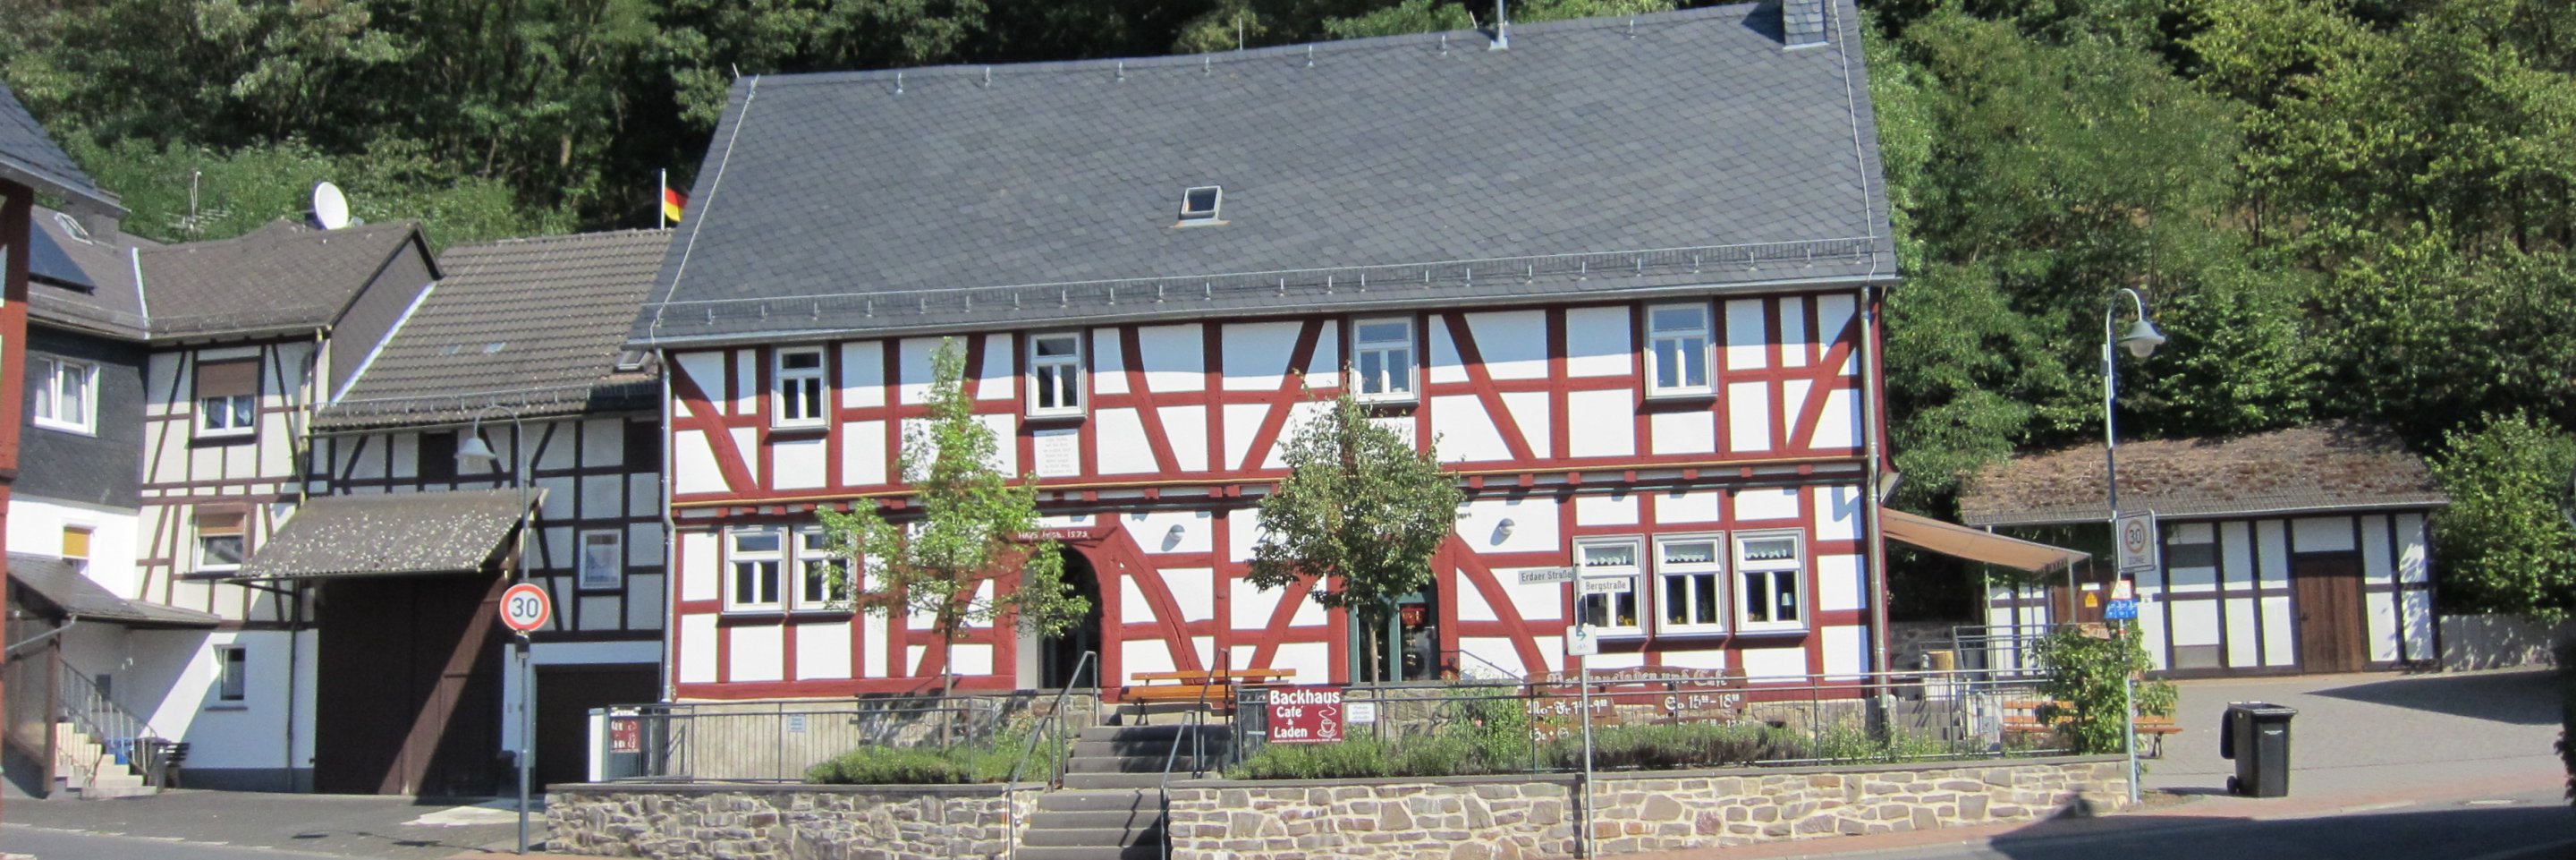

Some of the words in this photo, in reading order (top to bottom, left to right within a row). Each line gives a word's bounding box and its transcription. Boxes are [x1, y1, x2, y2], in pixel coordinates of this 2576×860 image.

[2129, 528, 2142, 544] 30
[1521, 571, 1545, 582] Erdaer
[1547, 569, 1572, 580] Straße
[1585, 580, 1626, 592] Bergstraße
[512, 597, 538, 617] 30
[1270, 688, 1341, 705] Backhaus
[1286, 718, 1294, 726] &
[1274, 726, 1308, 738] Laden
